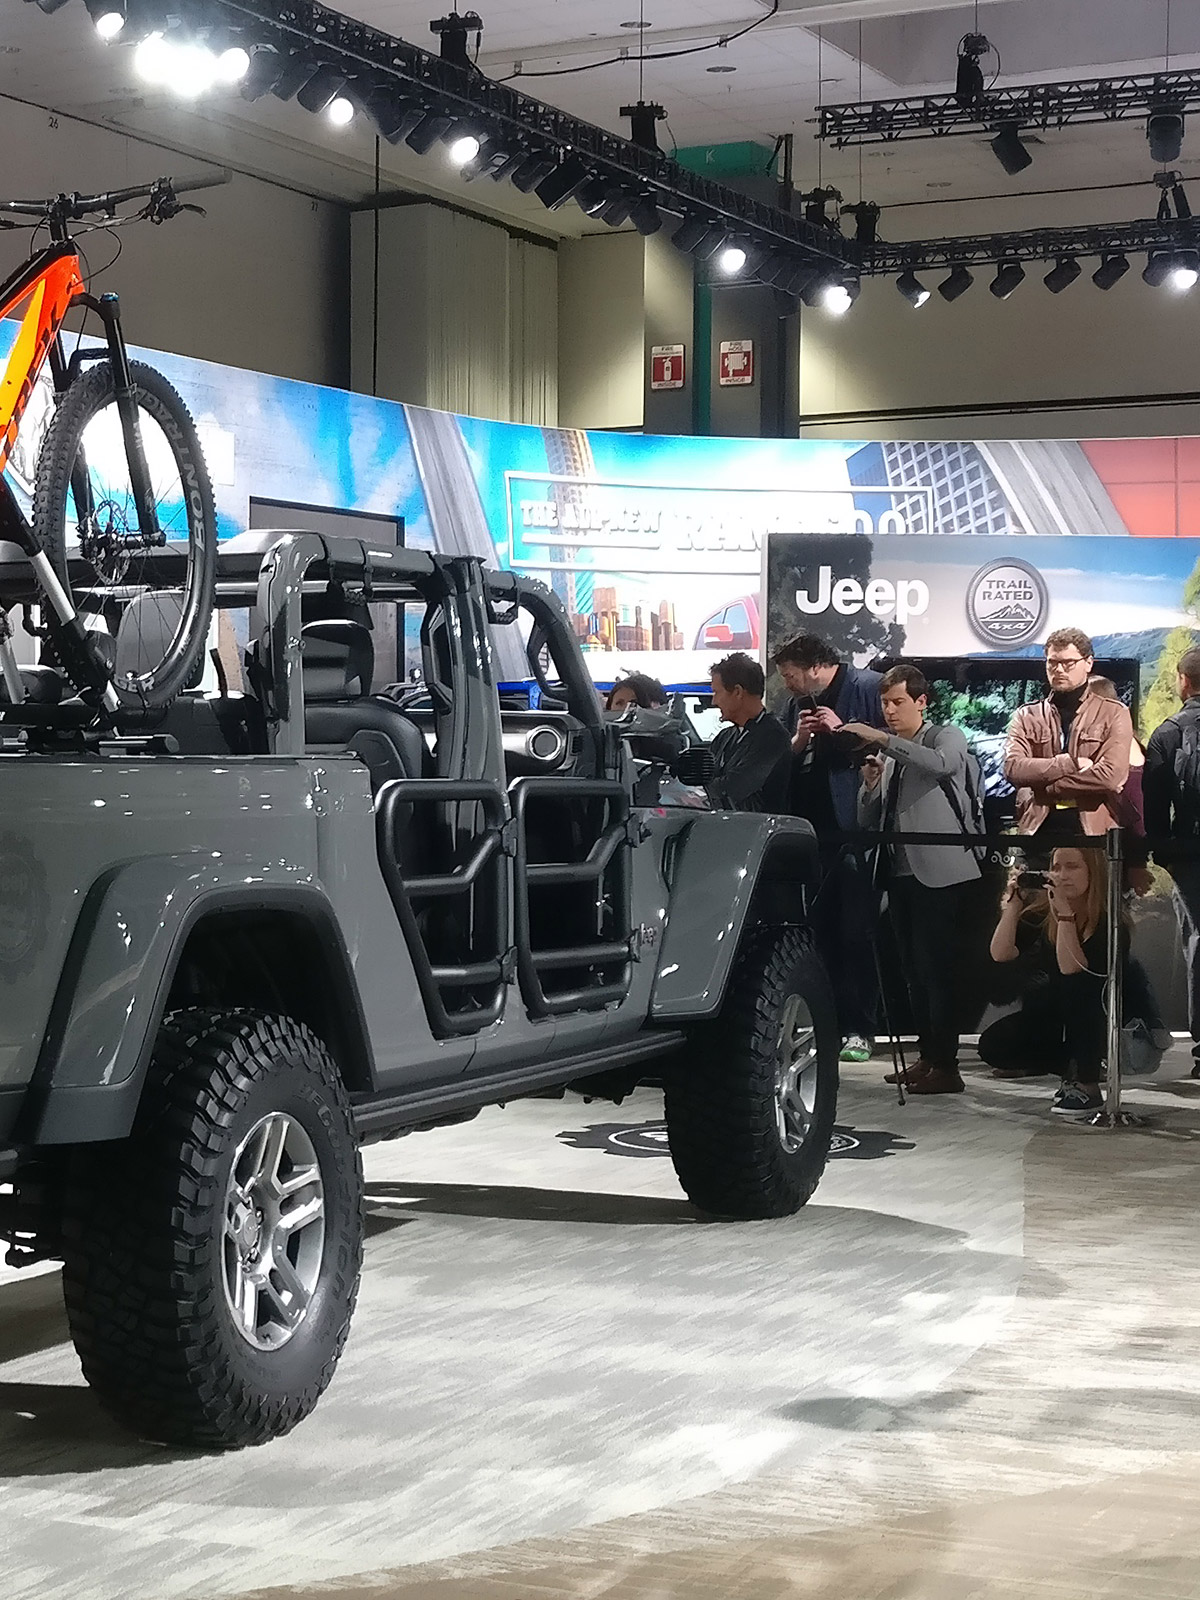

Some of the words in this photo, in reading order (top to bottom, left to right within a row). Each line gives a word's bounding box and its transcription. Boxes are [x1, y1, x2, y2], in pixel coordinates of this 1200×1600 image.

[705, 150, 715, 164] K
[520, 500, 559, 528] THE
[986, 580, 1032, 589] TRAIL
[795, 565, 930, 625] Jeep
[982, 590, 1034, 601] RATED
